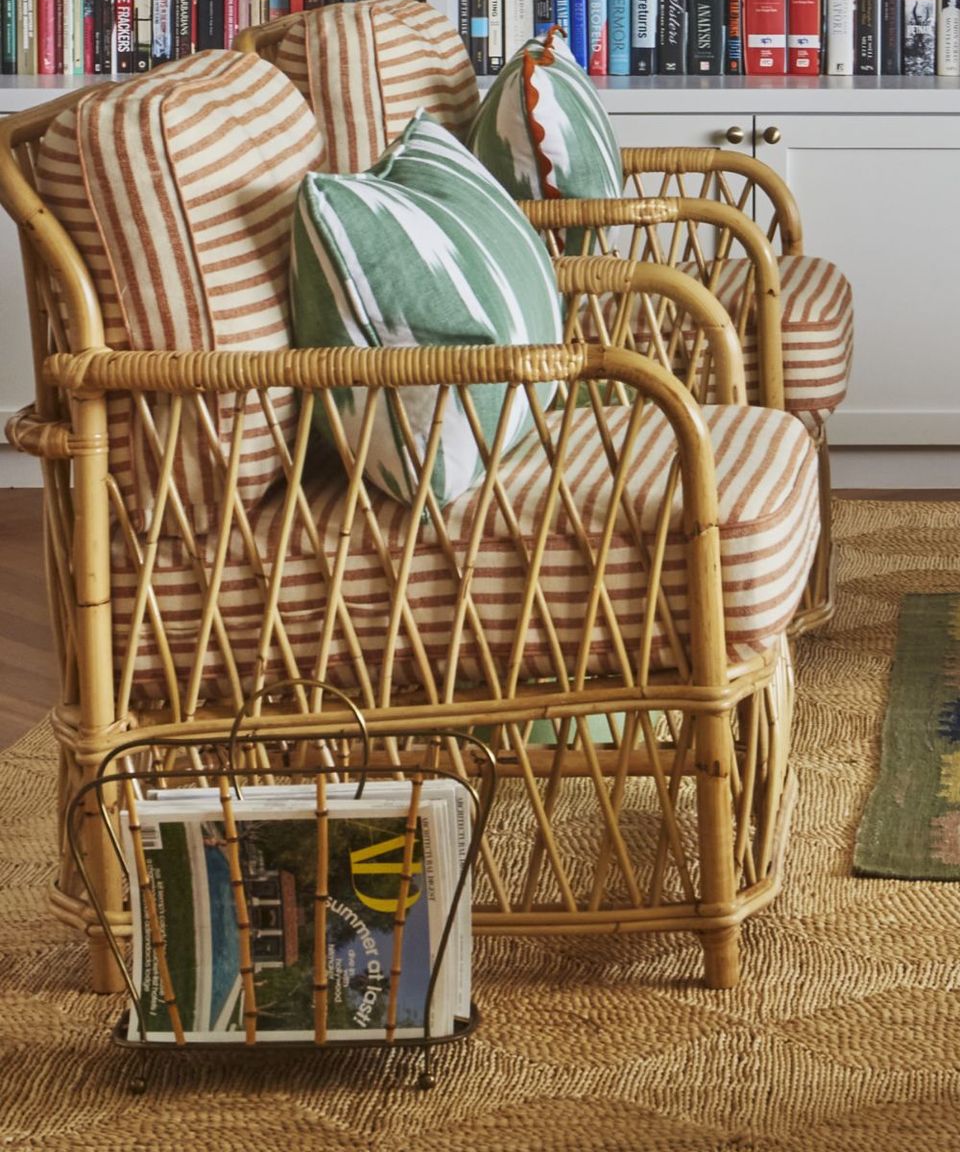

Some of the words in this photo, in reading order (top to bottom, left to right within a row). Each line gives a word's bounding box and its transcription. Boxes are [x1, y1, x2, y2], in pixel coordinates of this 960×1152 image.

[118, 6, 130, 52] FRACKERS
[591, 2, 602, 52] BLOFELD
[698, 4, 710, 49] ANALYSIS
[422, 817, 433, 873] ARCHITECTURAL
[427, 876, 435, 901] DIGEST
[324, 896, 379, 956] summer
[144, 968, 152, 991] lodge
[348, 949, 356, 966] dive
[368, 960, 384, 980] at
[334, 959, 342, 1003] hollywood
[353, 986, 382, 1027] last!
